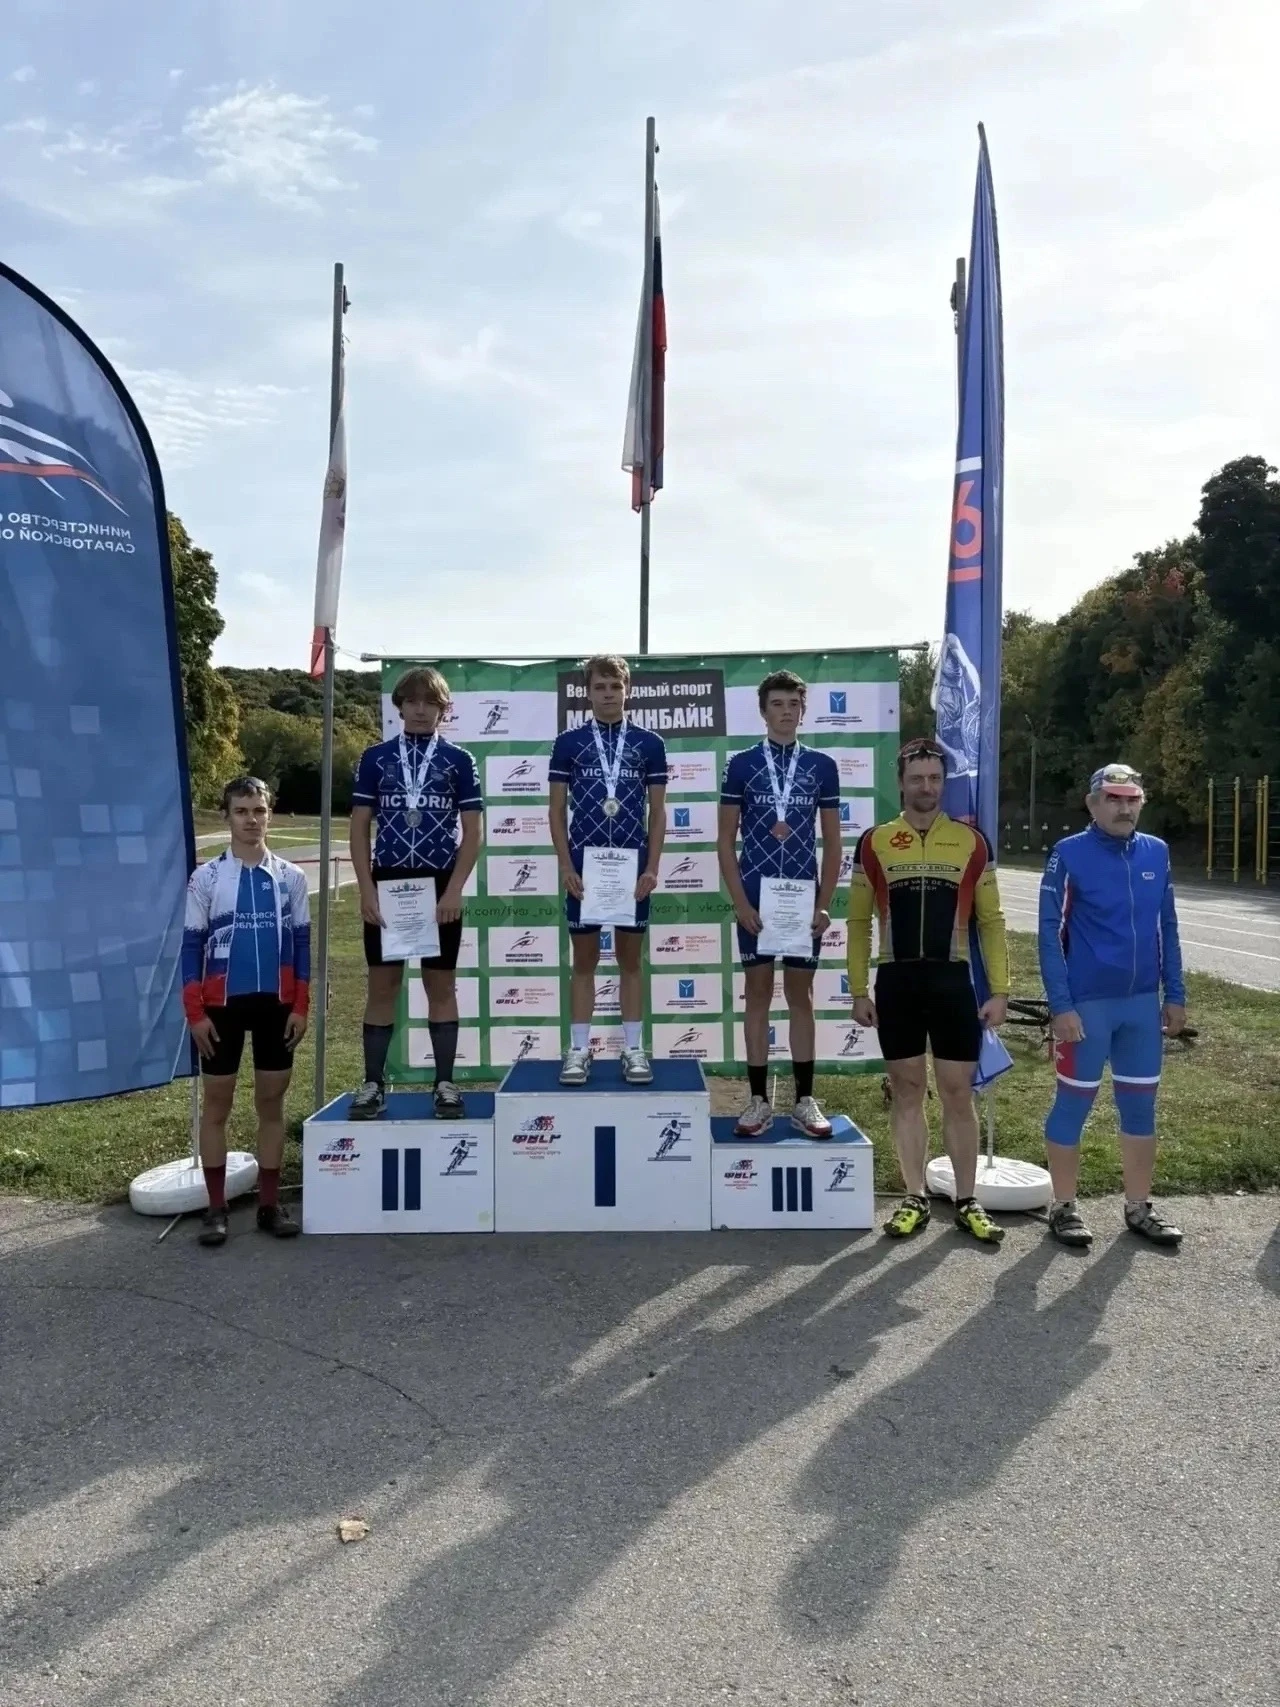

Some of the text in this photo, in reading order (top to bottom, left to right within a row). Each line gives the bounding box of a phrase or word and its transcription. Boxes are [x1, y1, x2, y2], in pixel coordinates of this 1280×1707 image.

[566, 683, 713, 699] Велдный спорт
[581, 767, 639, 778] VICRIA
[753, 794, 814, 806] VICORIA
[235, 911, 276, 920] РАТОВСК
